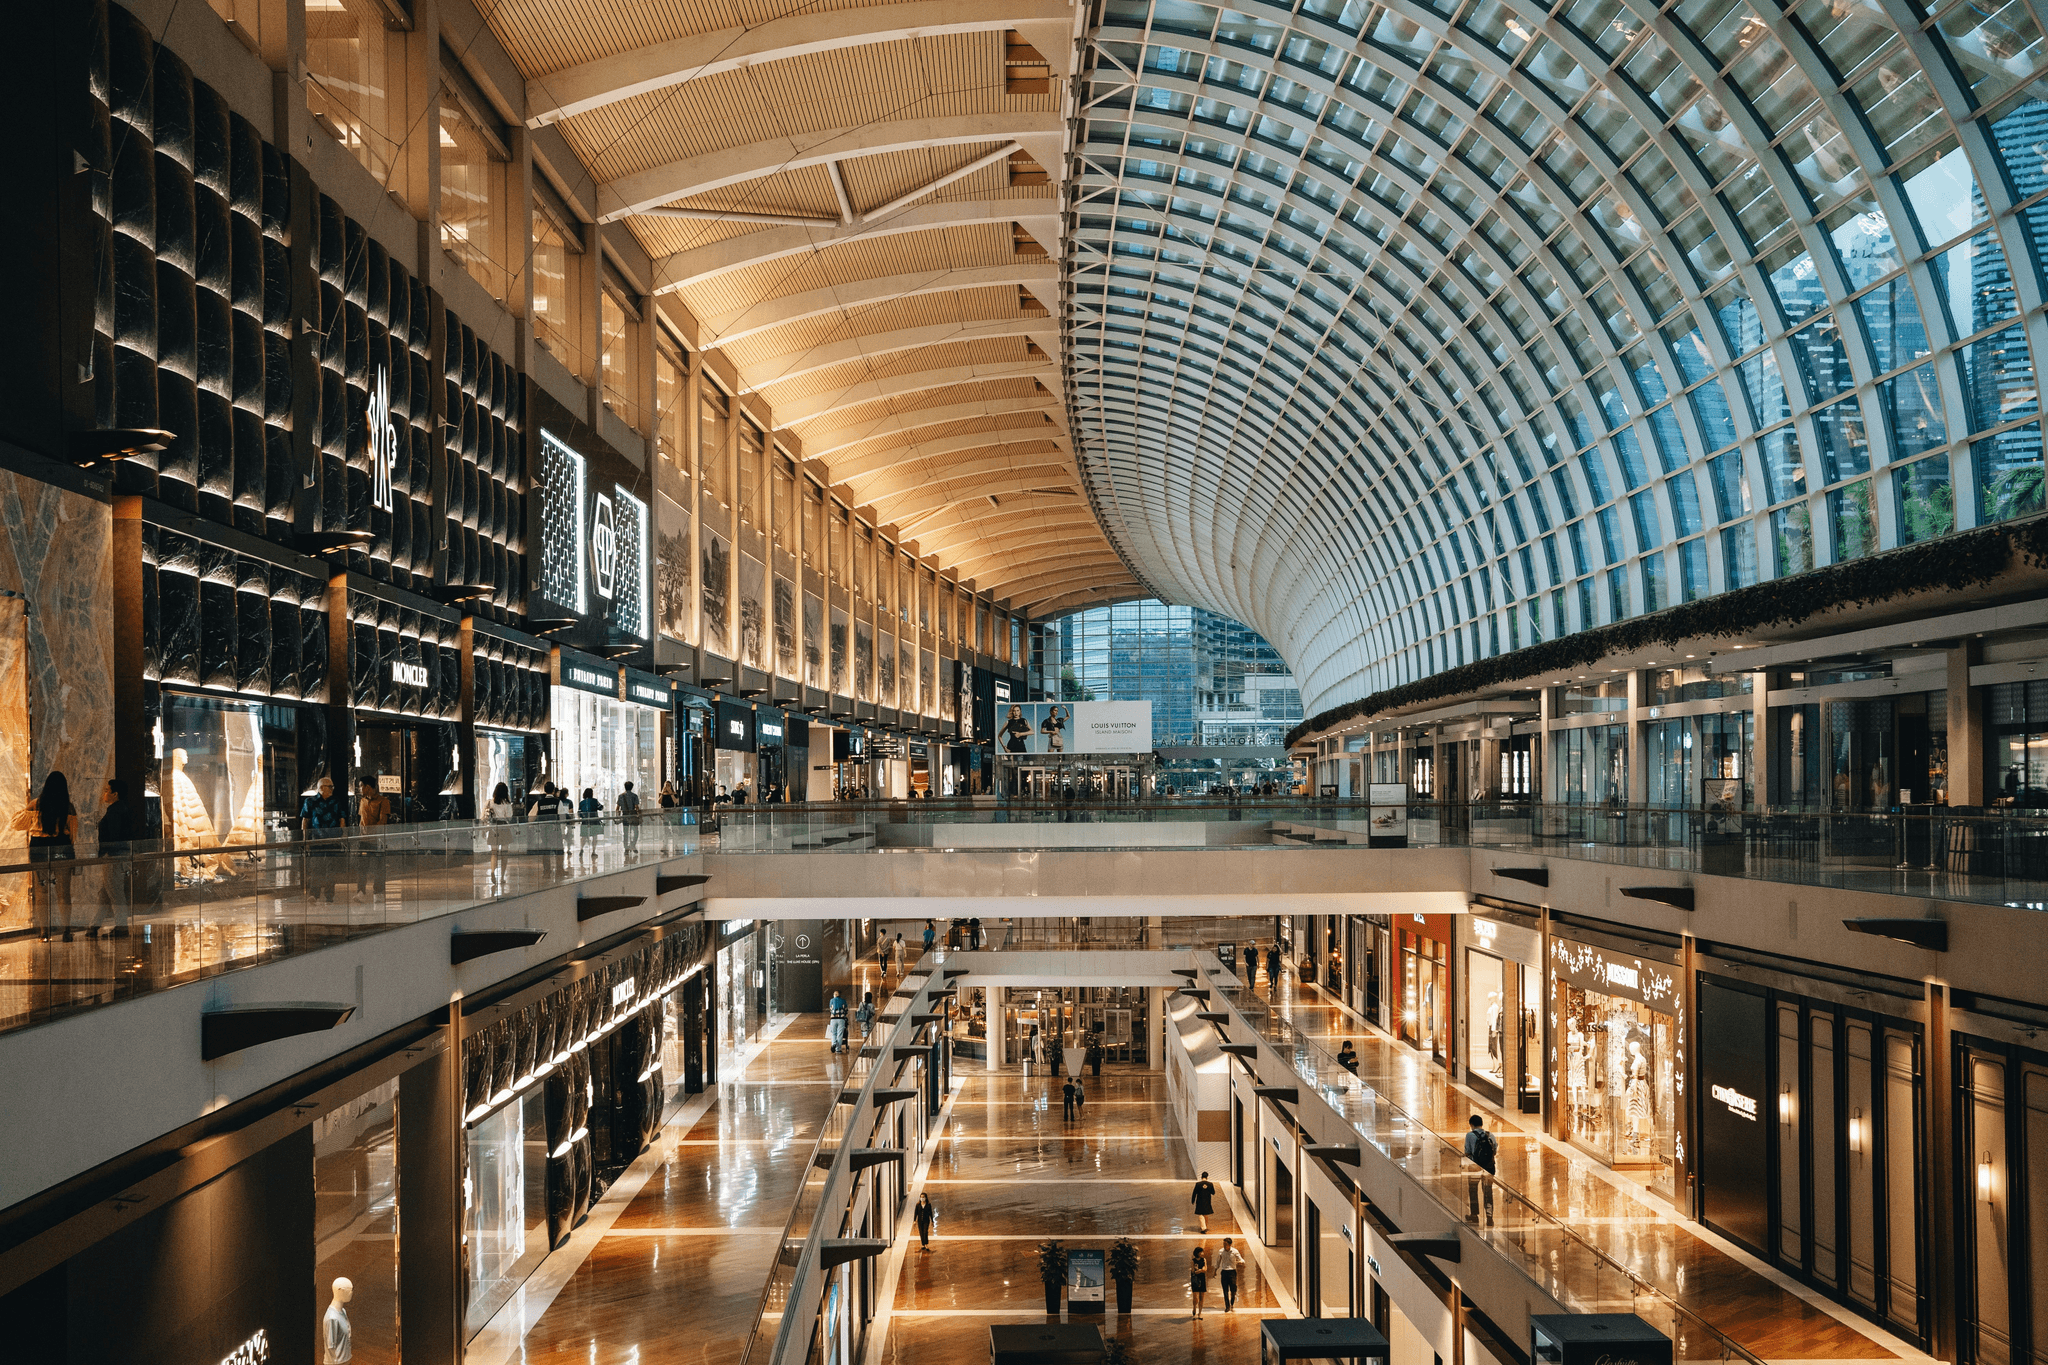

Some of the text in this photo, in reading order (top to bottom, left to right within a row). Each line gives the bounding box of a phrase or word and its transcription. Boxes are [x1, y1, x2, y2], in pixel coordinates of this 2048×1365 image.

[392, 661, 428, 687] MONCLER
[573, 667, 596, 686] PHILIPP
[636, 685, 654, 700] PHILIPP
[1607, 962, 1639, 990] MISSONI
[612, 976, 635, 1008] MONCLER
